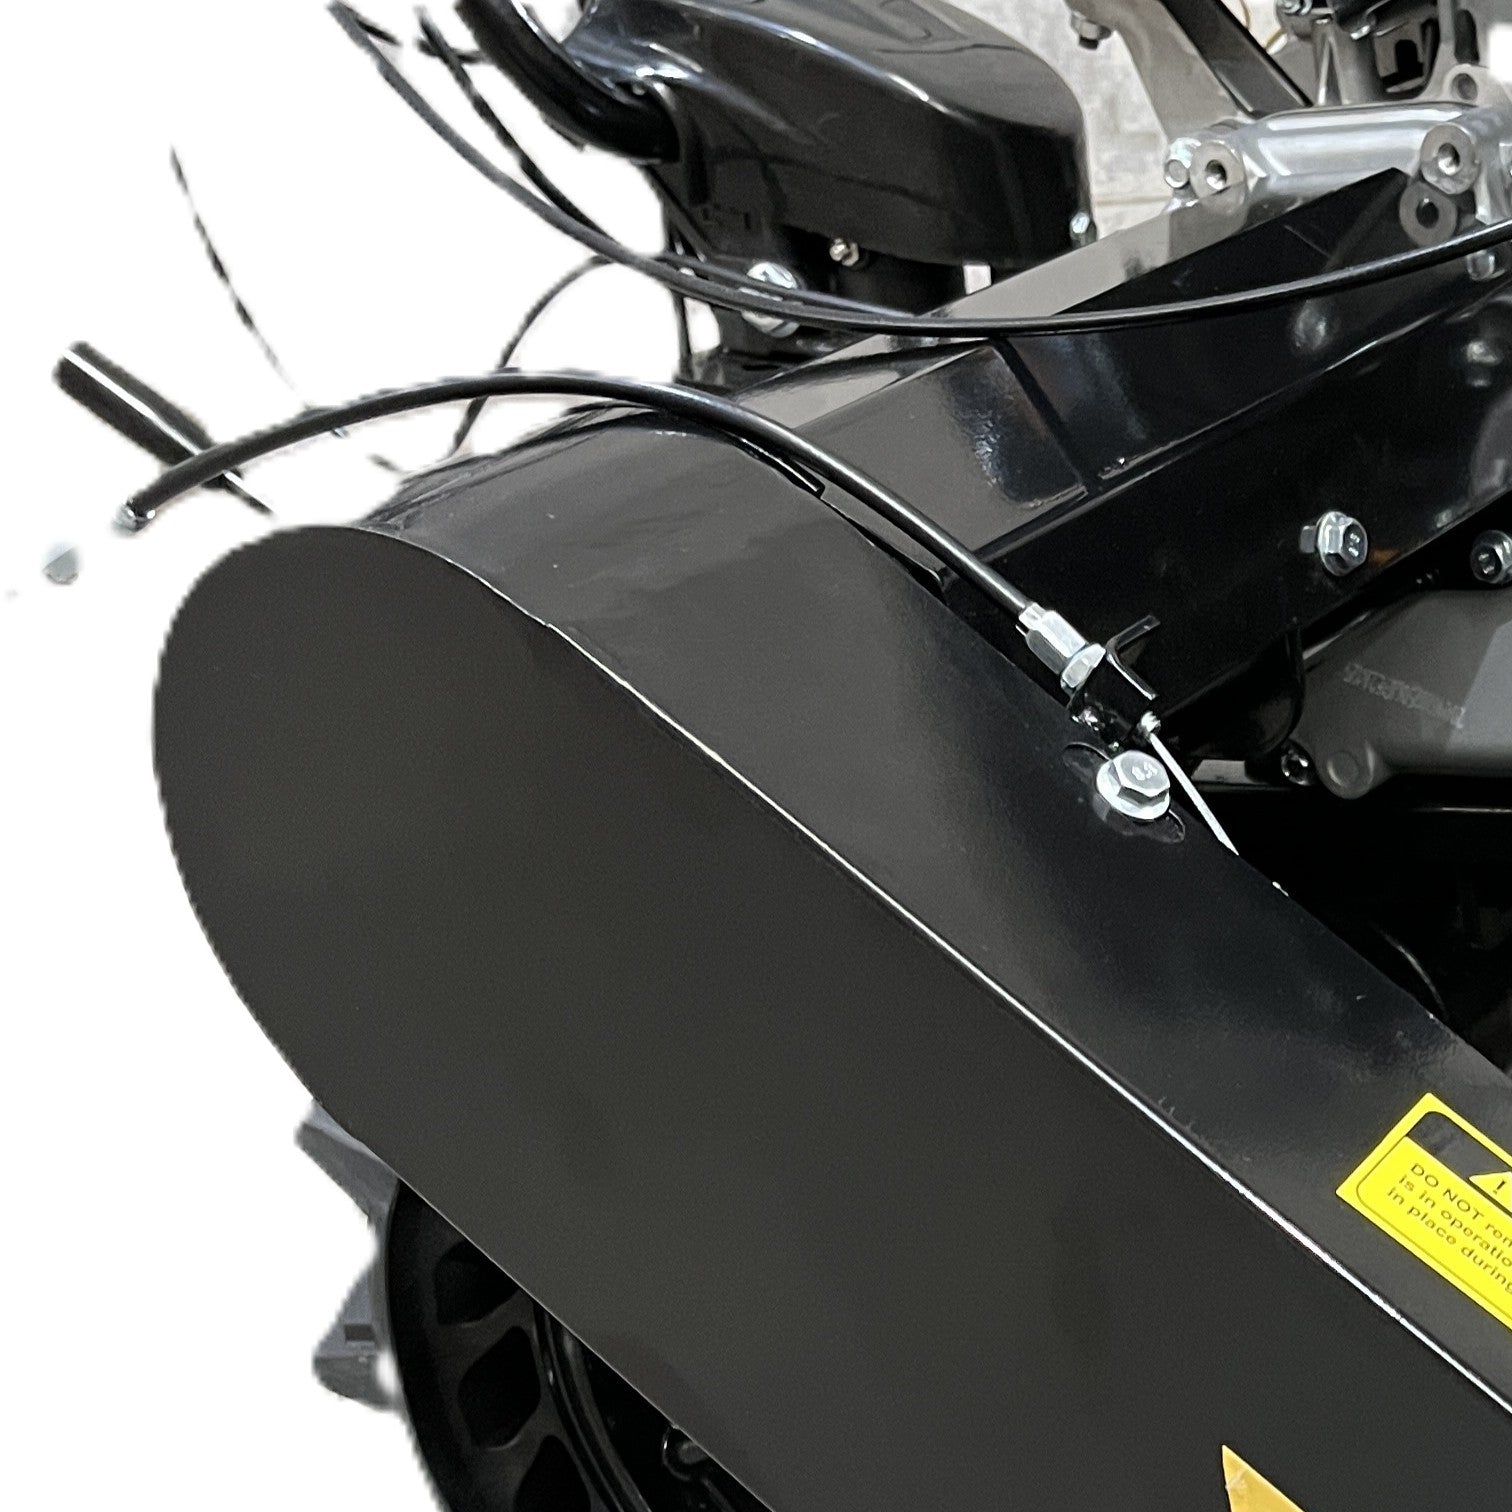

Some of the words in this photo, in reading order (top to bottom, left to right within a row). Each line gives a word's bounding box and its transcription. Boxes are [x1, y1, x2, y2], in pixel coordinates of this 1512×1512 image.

[1386, 1187, 1405, 1206] in
[1406, 1206, 1457, 1245] place
[1398, 1174, 1416, 1192] is
[1418, 1189, 1436, 1209] in
[1410, 1163, 1439, 1188] DO
[1443, 1188, 1485, 1220] NOT
